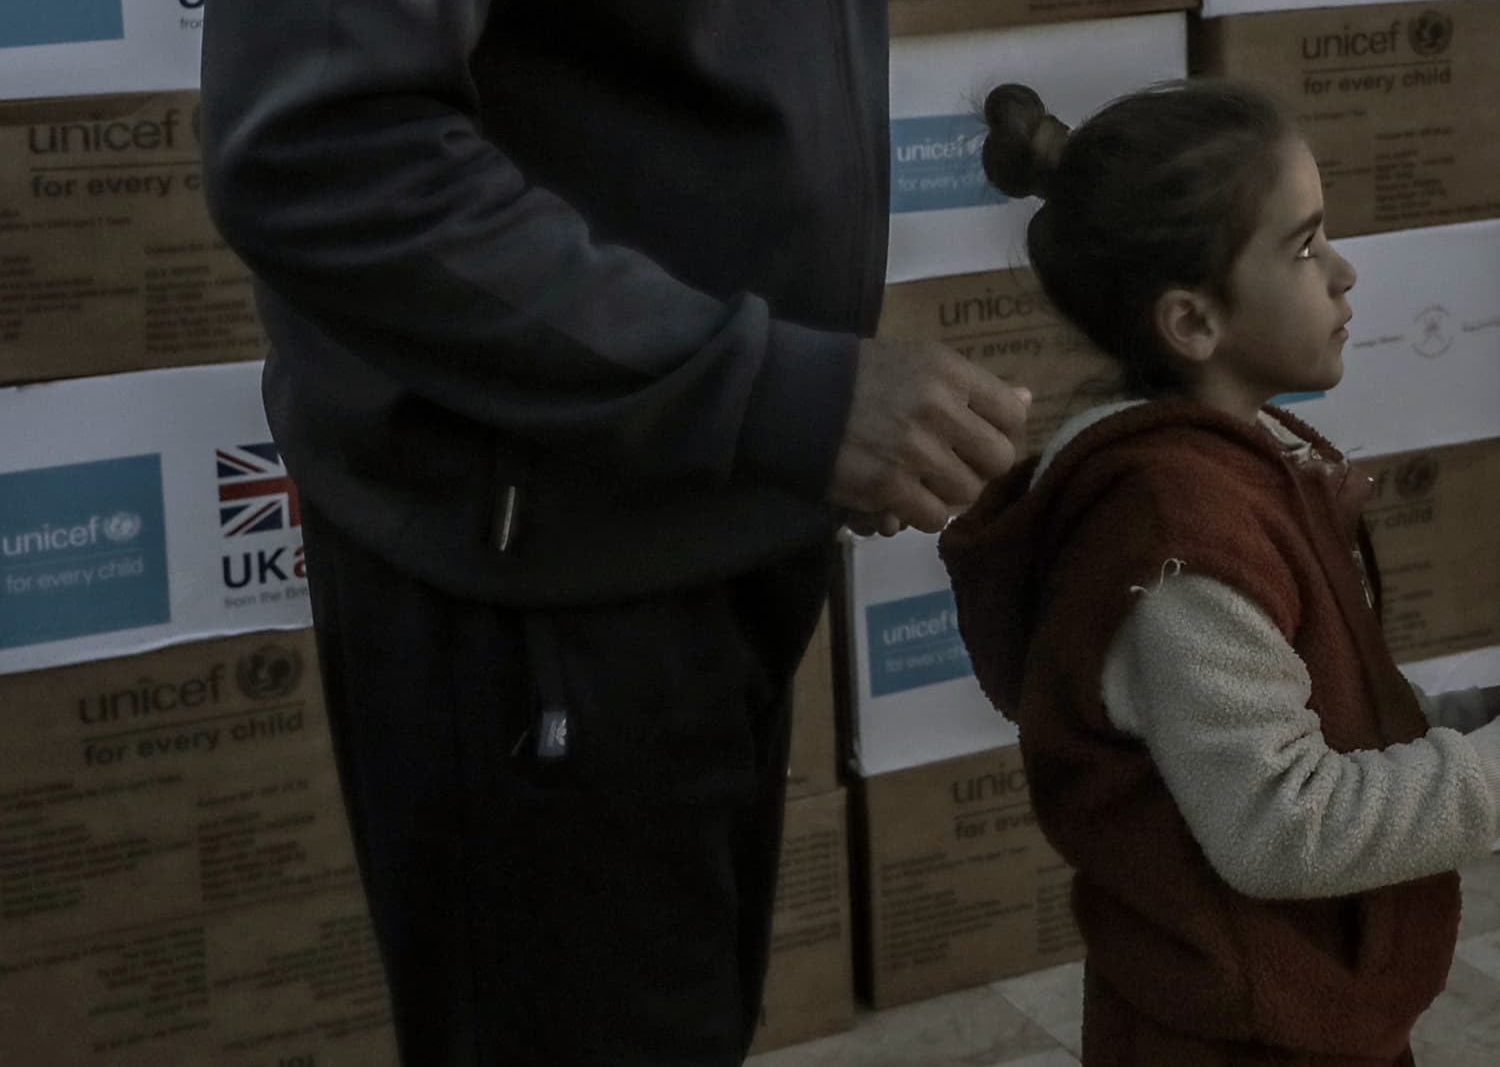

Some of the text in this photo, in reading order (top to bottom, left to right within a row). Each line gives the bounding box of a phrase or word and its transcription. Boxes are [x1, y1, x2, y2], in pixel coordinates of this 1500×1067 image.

[1302, 20, 1400, 60] unicef
[1303, 66, 1452, 95] for every child
[28, 108, 180, 155] unicef
[32, 174, 172, 198] for every
[938, 289, 1033, 328] unice
[3, 516, 97, 556] unicef
[101, 555, 144, 578] child
[78, 662, 225, 727] unicef
[83, 712, 305, 767] for every child
[952, 760, 1027, 804] unic
[954, 821, 988, 841] for
